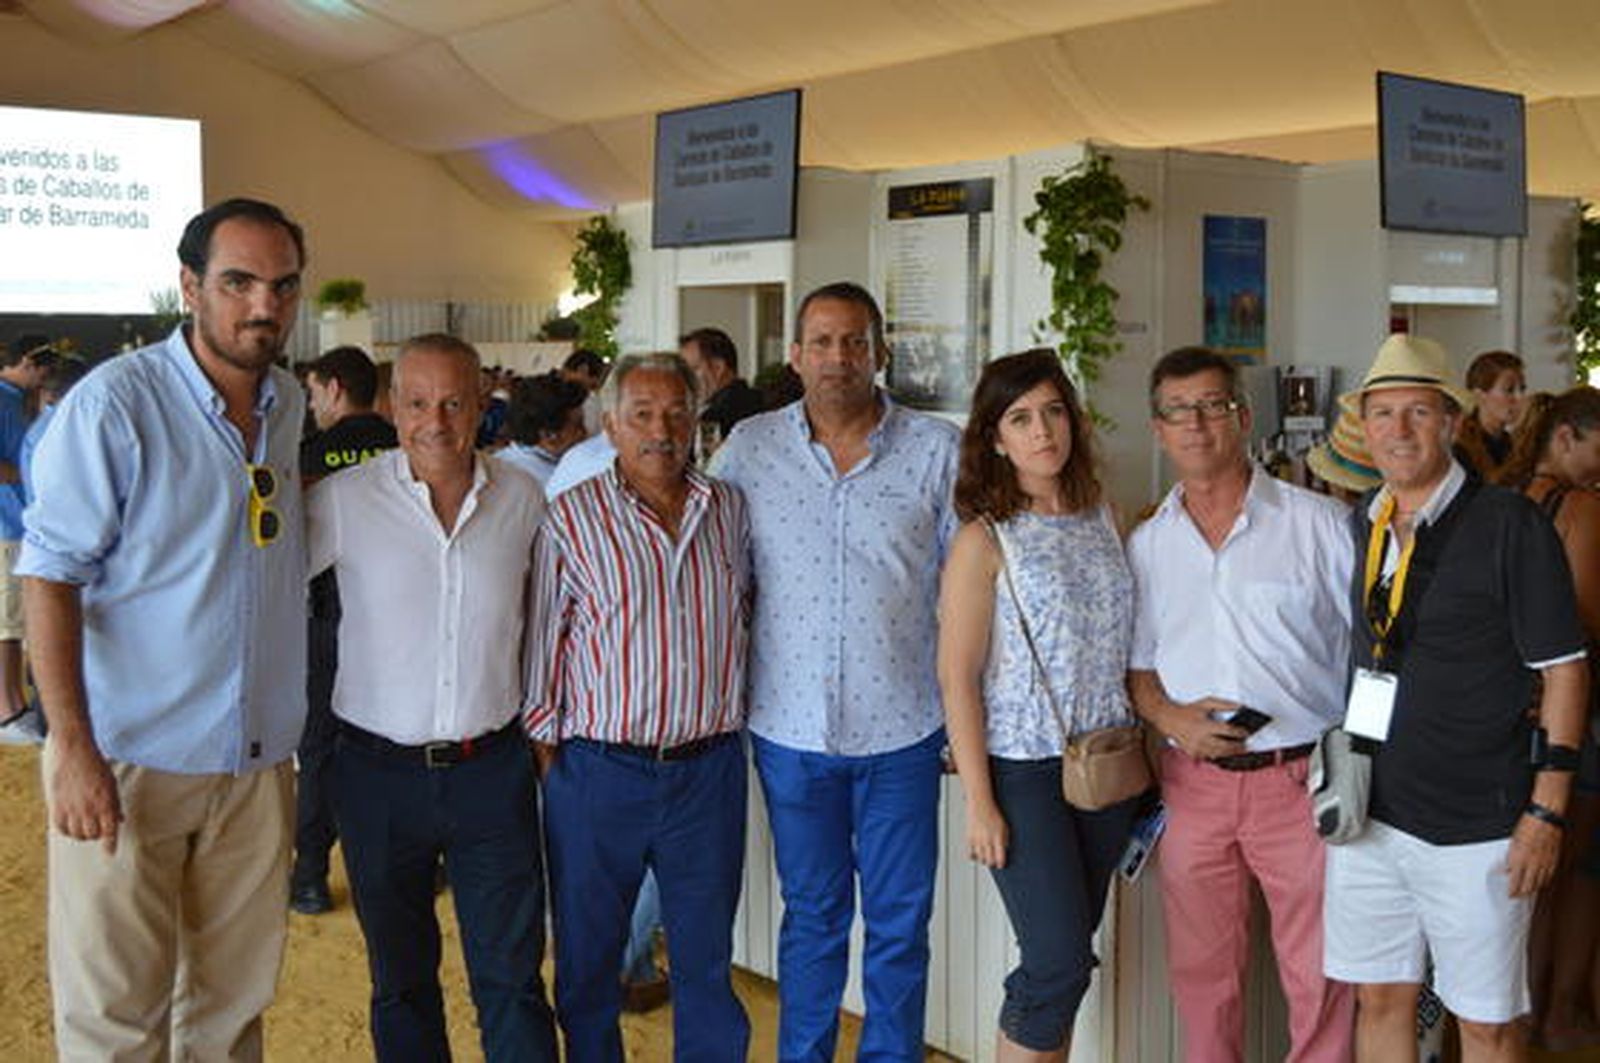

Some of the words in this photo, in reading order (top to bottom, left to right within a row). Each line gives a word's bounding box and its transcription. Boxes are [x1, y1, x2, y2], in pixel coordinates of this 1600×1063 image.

[76, 154, 88, 171] a
[92, 149, 120, 173] las
[13, 176, 38, 197] de
[42, 174, 122, 199] Caballos
[127, 181, 151, 201] de
[19, 205, 44, 226] de
[48, 204, 150, 230] Barrameda
